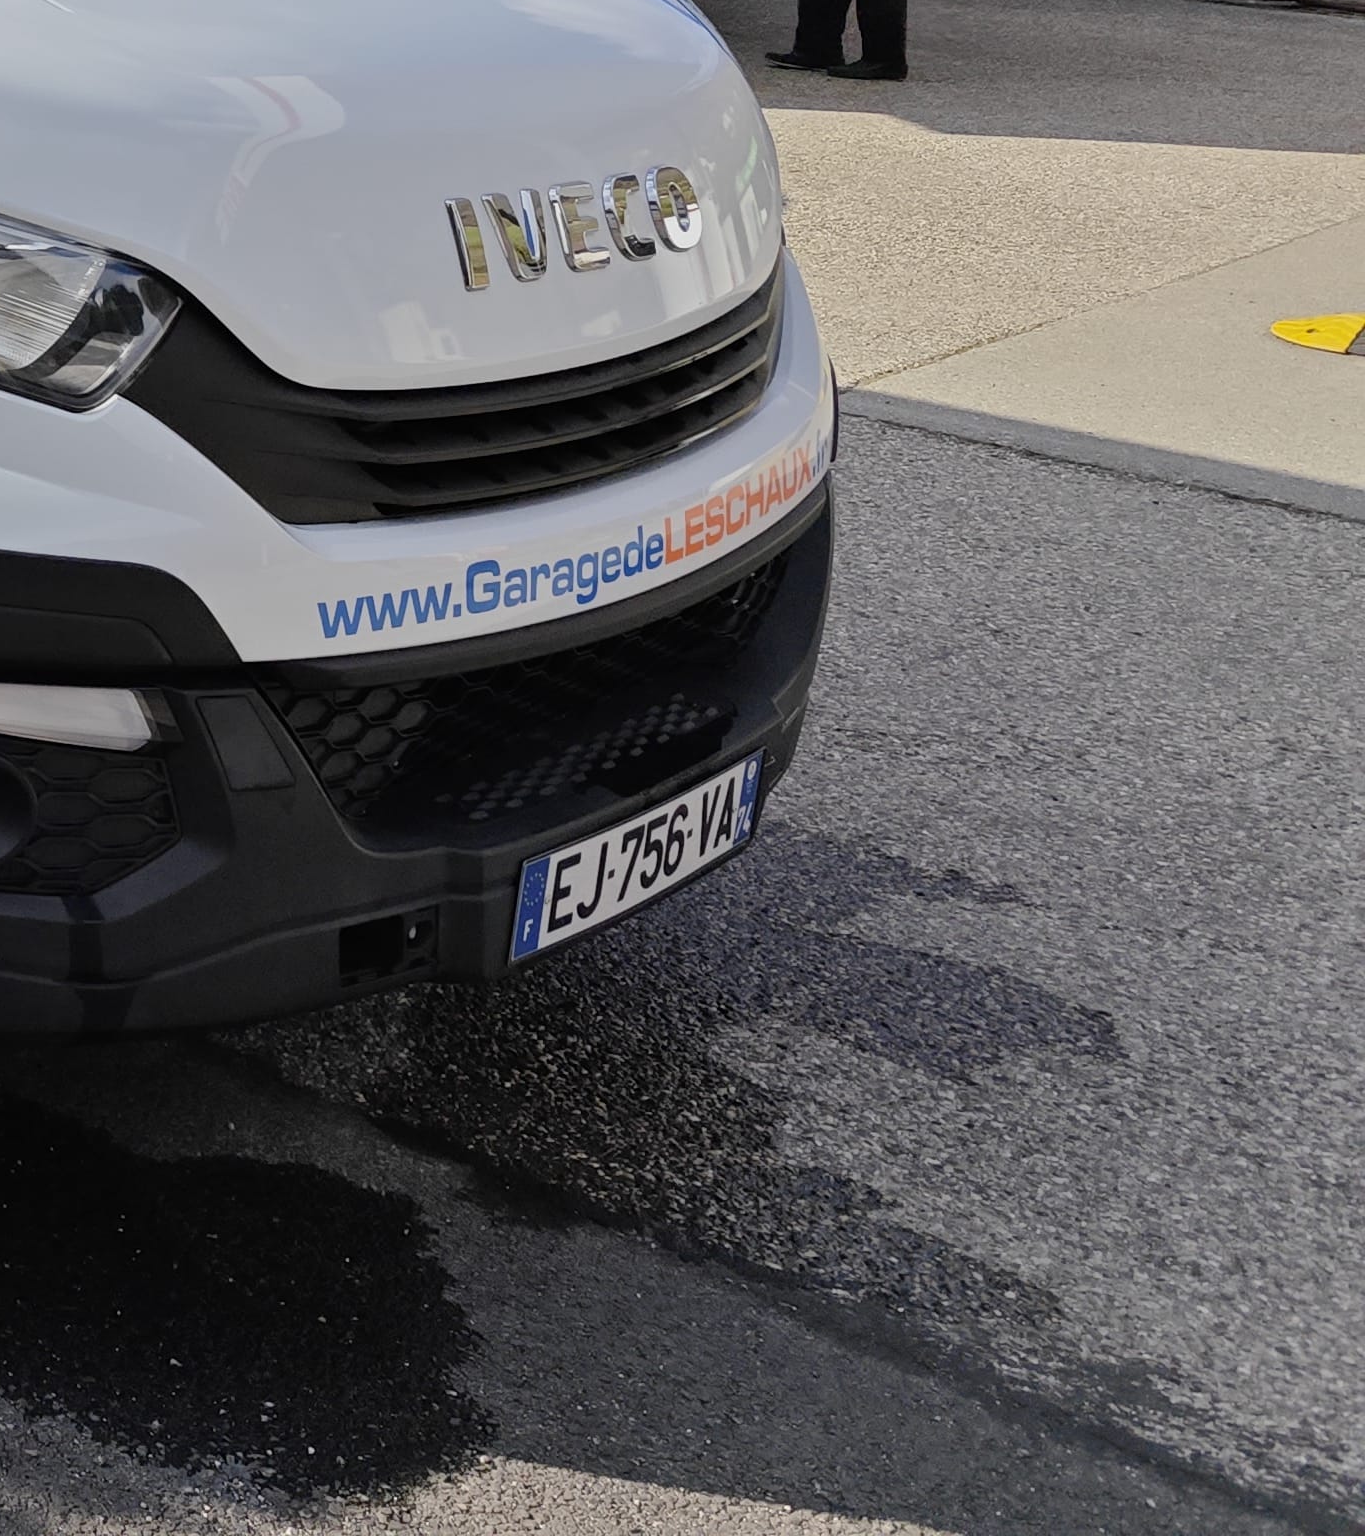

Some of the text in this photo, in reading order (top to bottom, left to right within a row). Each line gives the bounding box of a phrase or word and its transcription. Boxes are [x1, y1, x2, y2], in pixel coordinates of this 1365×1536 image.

[444, 166, 703, 292] IVECO
[735, 801, 753, 840] 74
[523, 918, 533, 942] F
